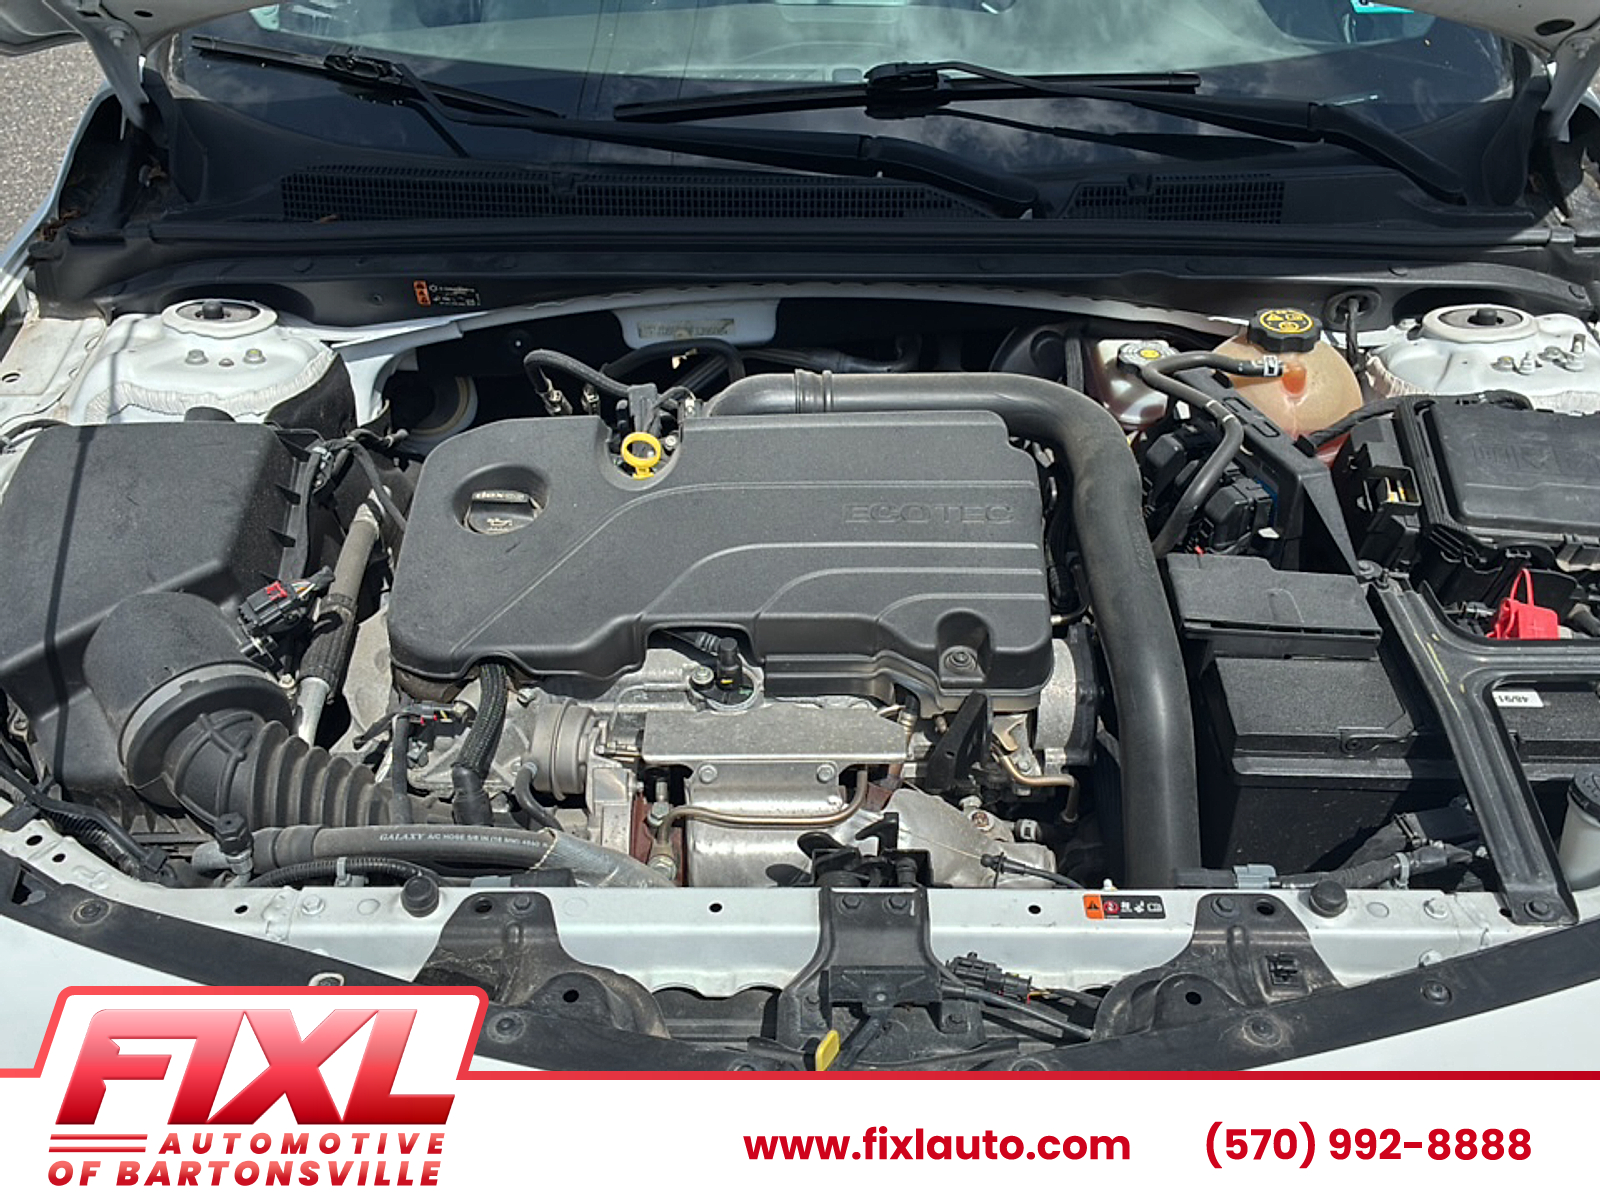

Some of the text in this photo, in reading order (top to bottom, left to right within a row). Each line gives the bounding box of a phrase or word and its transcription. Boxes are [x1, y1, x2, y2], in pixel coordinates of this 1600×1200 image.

[842, 502, 1016, 525] ECOTEC
[379, 833, 426, 842] GALAXY
[443, 833, 465, 842] HOSE
